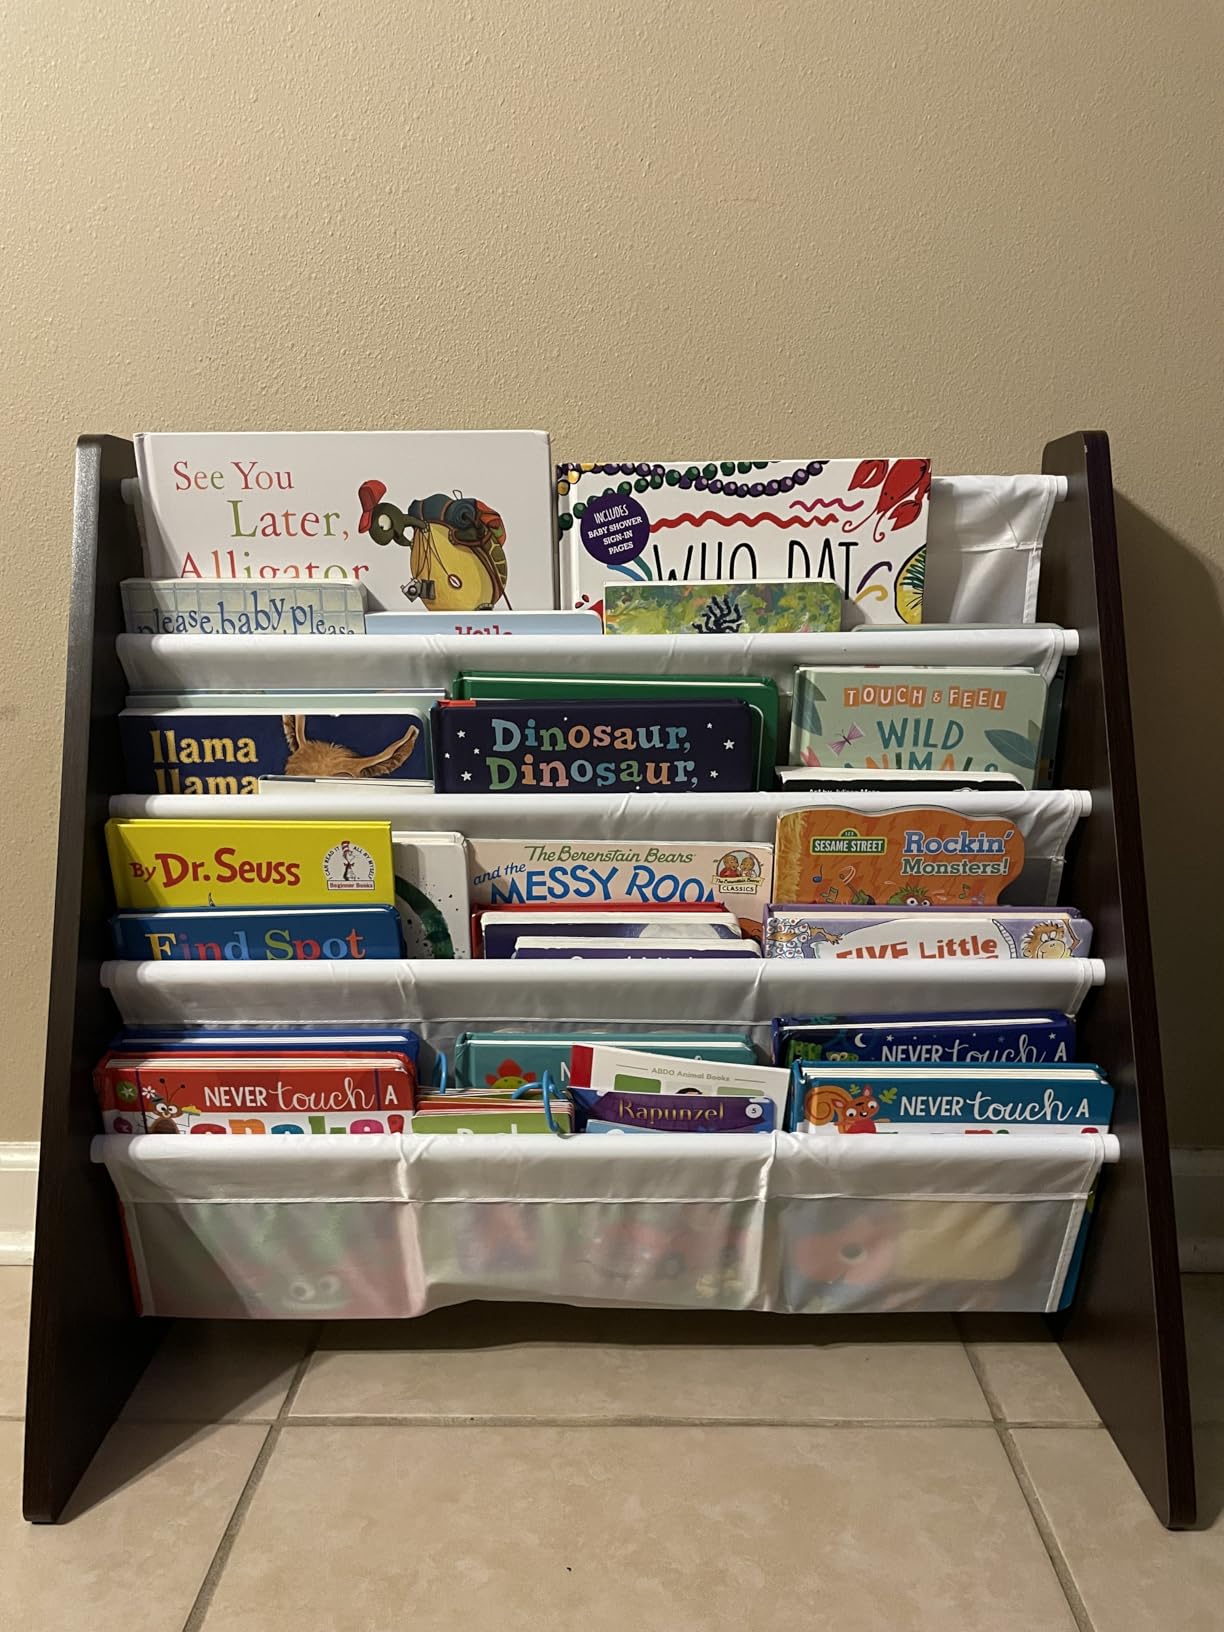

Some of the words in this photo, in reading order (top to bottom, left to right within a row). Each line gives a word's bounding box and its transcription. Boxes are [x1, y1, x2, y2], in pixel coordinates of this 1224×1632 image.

[173, 460, 225, 492] See
[231, 461, 295, 491] You
[227, 499, 349, 542] Later,
[587, 526, 608, 539] BABY
[608, 516, 643, 532] SHOWER
[593, 504, 629, 524] INCLUDES
[602, 530, 633, 545] SIGN-IN
[608, 541, 634, 555] PAGES
[788, 538, 859, 600] DAT
[848, 687, 923, 705] TOUCH
[932, 692, 943, 702] &
[950, 689, 1004, 710] FEEL
[149, 729, 258, 764] llama
[491, 718, 691, 753] Dinosaur,
[876, 717, 965, 750] WILD
[154, 767, 259, 794] llama
[485, 753, 698, 790] Dinosaur,
[524, 846, 555, 863] The
[557, 846, 641, 863] Berenstain
[643, 848, 694, 864] Bears
[814, 840, 849, 852] SESAME
[850, 840, 883, 852] STREET
[903, 830, 1013, 855] Rockin'
[129, 861, 156, 883] By
[154, 852, 211, 889] Dr.
[213, 847, 301, 886] Seuss
[473, 867, 500, 886] and
[504, 863, 527, 876] the
[901, 858, 1009, 876] Monsters!
[491, 864, 619, 904] MESSY
[145, 930, 249, 960] Find
[264, 928, 366, 960] Spot
[919, 935, 998, 959] Little
[882, 1045, 943, 1061] NEVER
[945, 1034, 1046, 1062] touch
[1053, 1041, 1067, 1061] A
[651, 1067, 675, 1076] ABDO
[677, 1071, 705, 1080] Animal
[706, 1073, 730, 1081] Books
[203, 1086, 269, 1107] NEVER
[268, 1077, 376, 1111] touch
[384, 1085, 399, 1105] A
[899, 1095, 963, 1117] NEVER
[965, 1088, 1073, 1121] touch
[1075, 1097, 1090, 1118] A
[618, 1099, 725, 1125] Rapunzel
